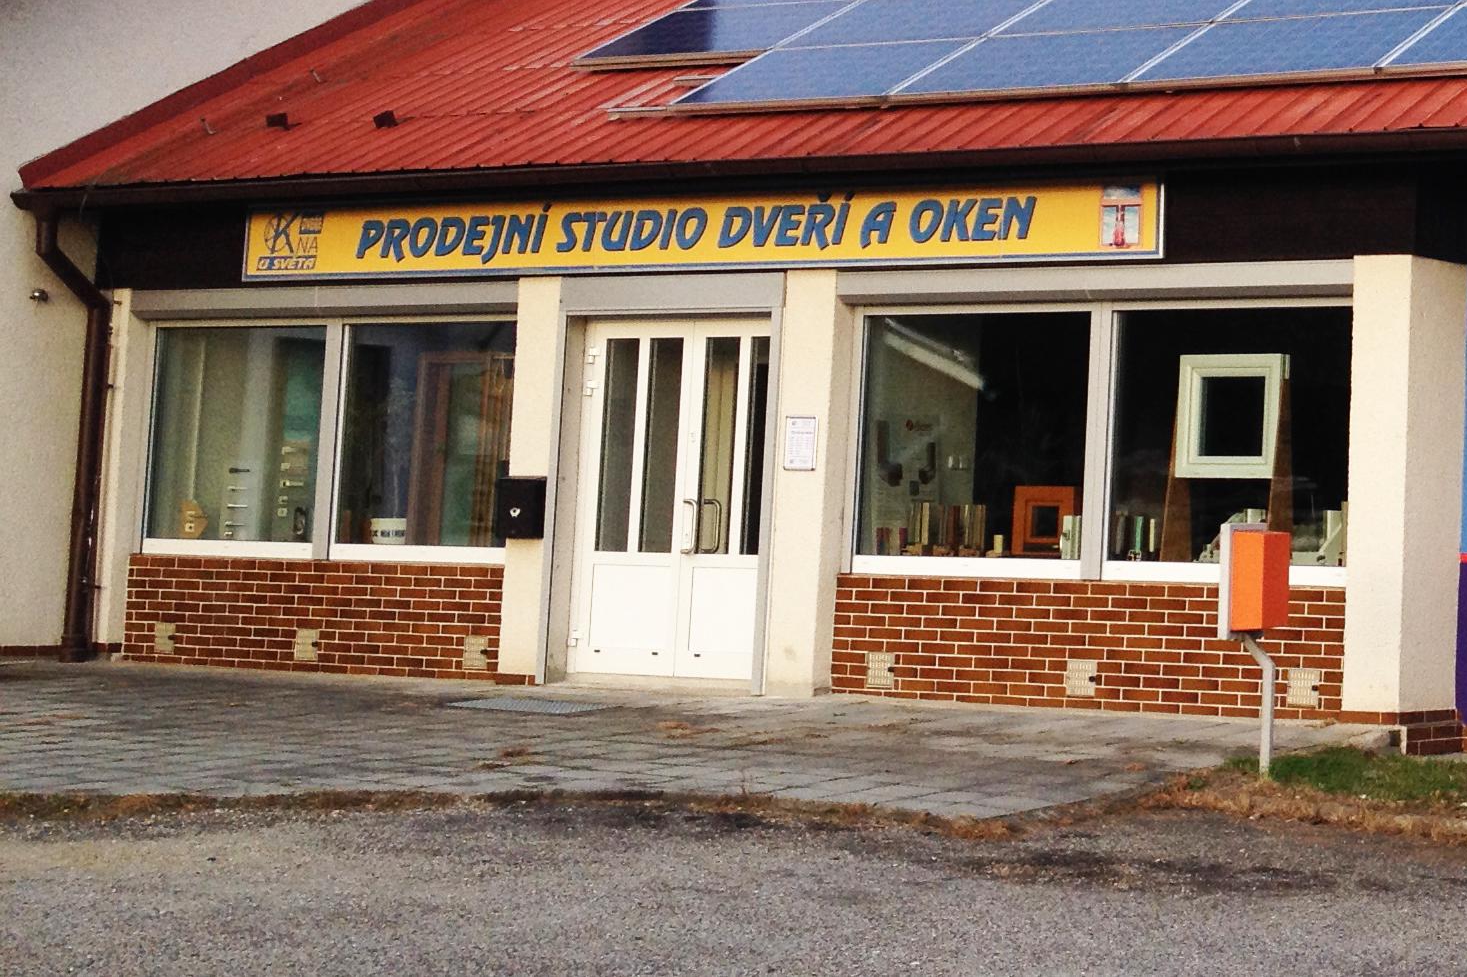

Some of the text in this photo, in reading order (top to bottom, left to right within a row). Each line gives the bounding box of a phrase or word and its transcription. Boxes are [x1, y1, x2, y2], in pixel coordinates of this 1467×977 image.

[355, 190, 1038, 264] PRODEJNÍ STUDIO DVEŘÍ A OKEN
